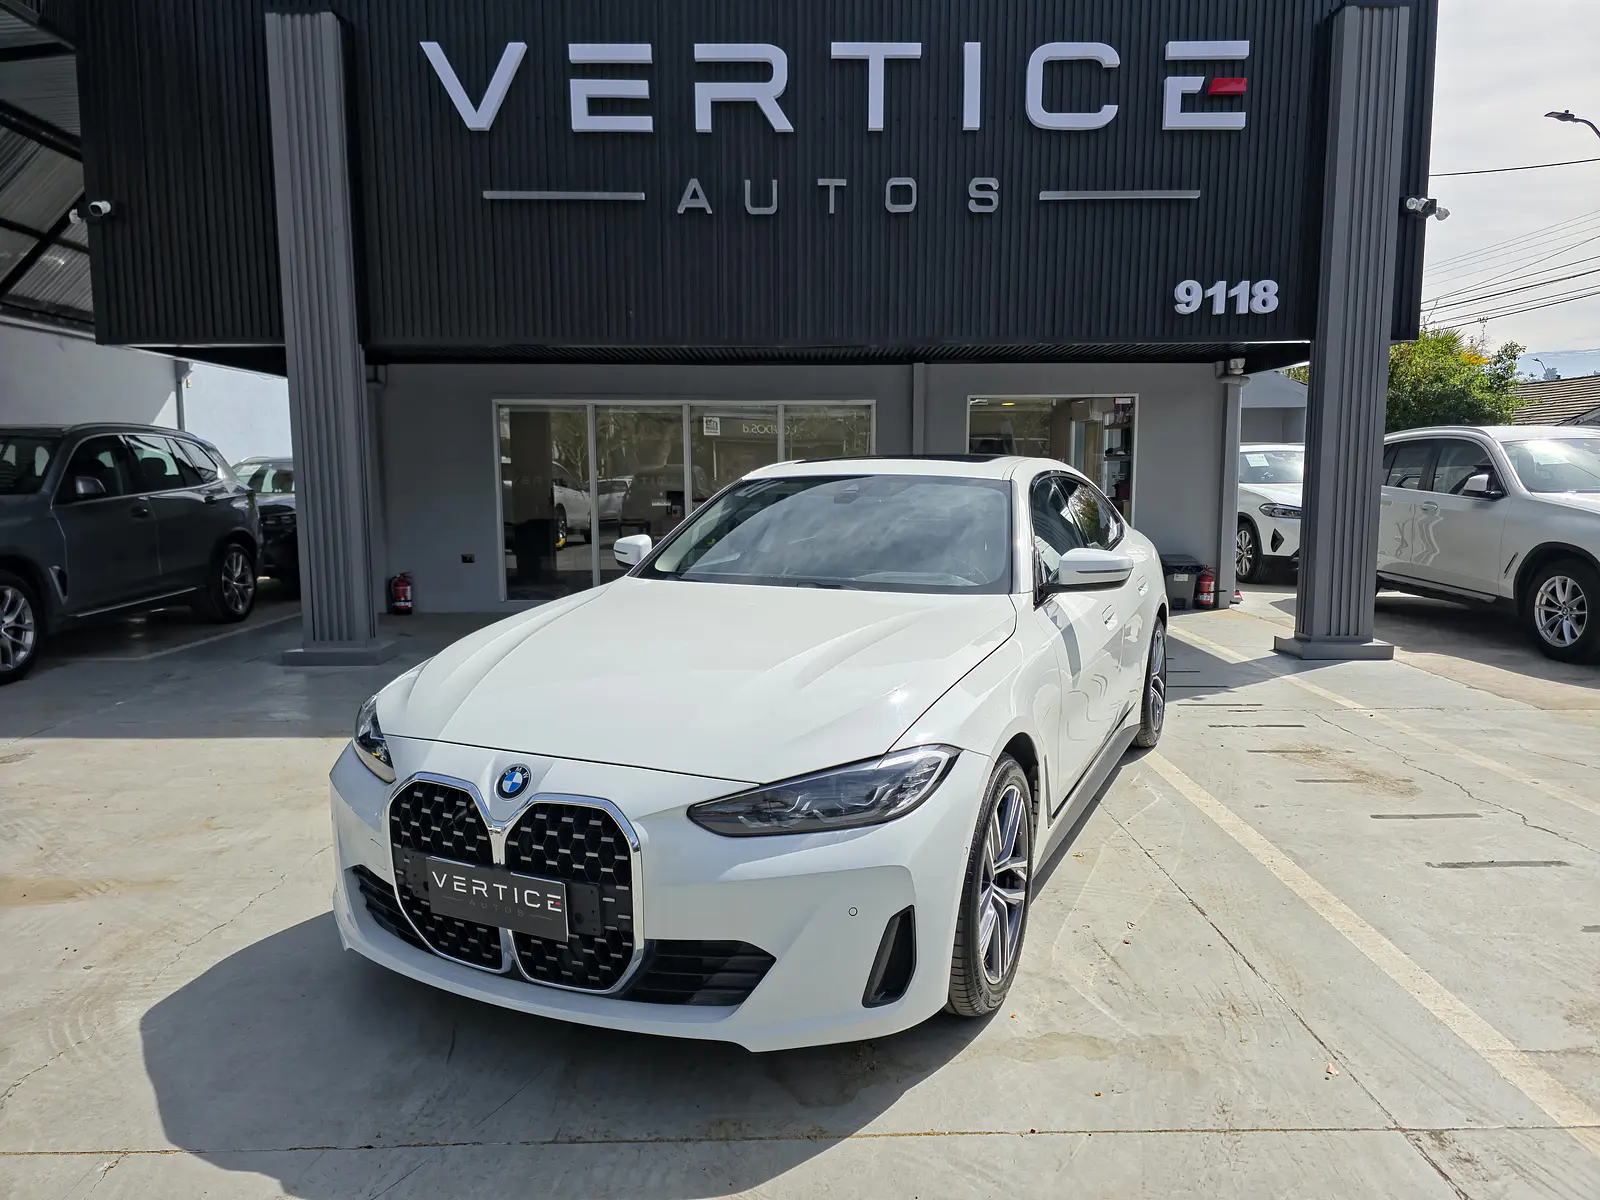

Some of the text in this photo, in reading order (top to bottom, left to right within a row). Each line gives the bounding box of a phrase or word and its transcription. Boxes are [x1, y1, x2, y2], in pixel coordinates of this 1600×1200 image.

[420, 41, 1249, 132] VERTICE
[677, 177, 999, 214] AUTOS
[1174, 279, 1279, 315] 9118
[431, 871, 562, 912] VERTICE
[469, 899, 524, 916] AUTOS
